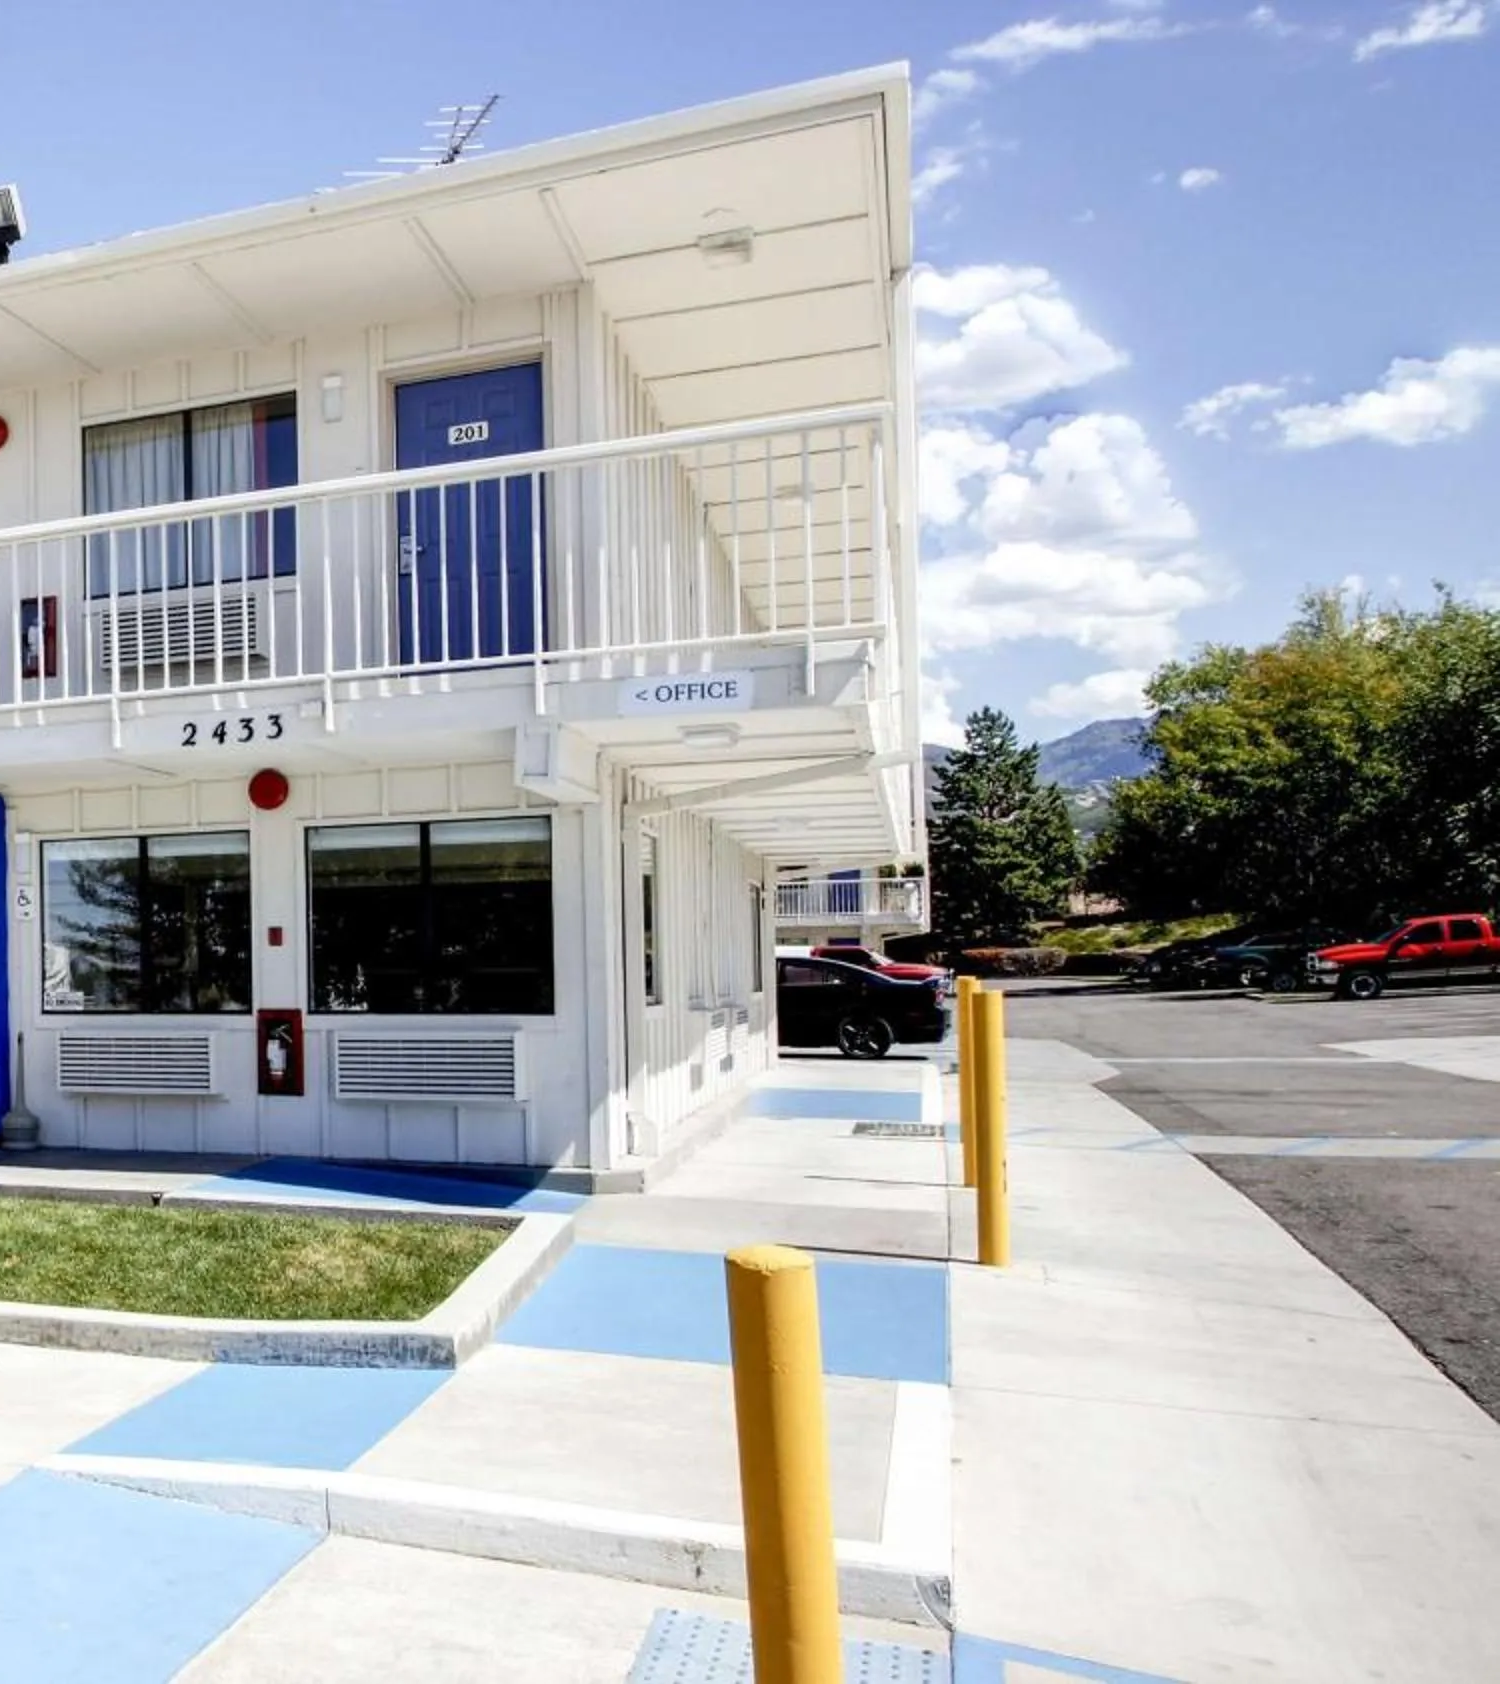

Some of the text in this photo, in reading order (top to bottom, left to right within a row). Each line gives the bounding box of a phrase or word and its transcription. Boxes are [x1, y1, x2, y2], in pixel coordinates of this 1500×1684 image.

[454, 425, 483, 441] 201
[655, 681, 738, 702] OFFICE
[181, 713, 283, 746] 2433
